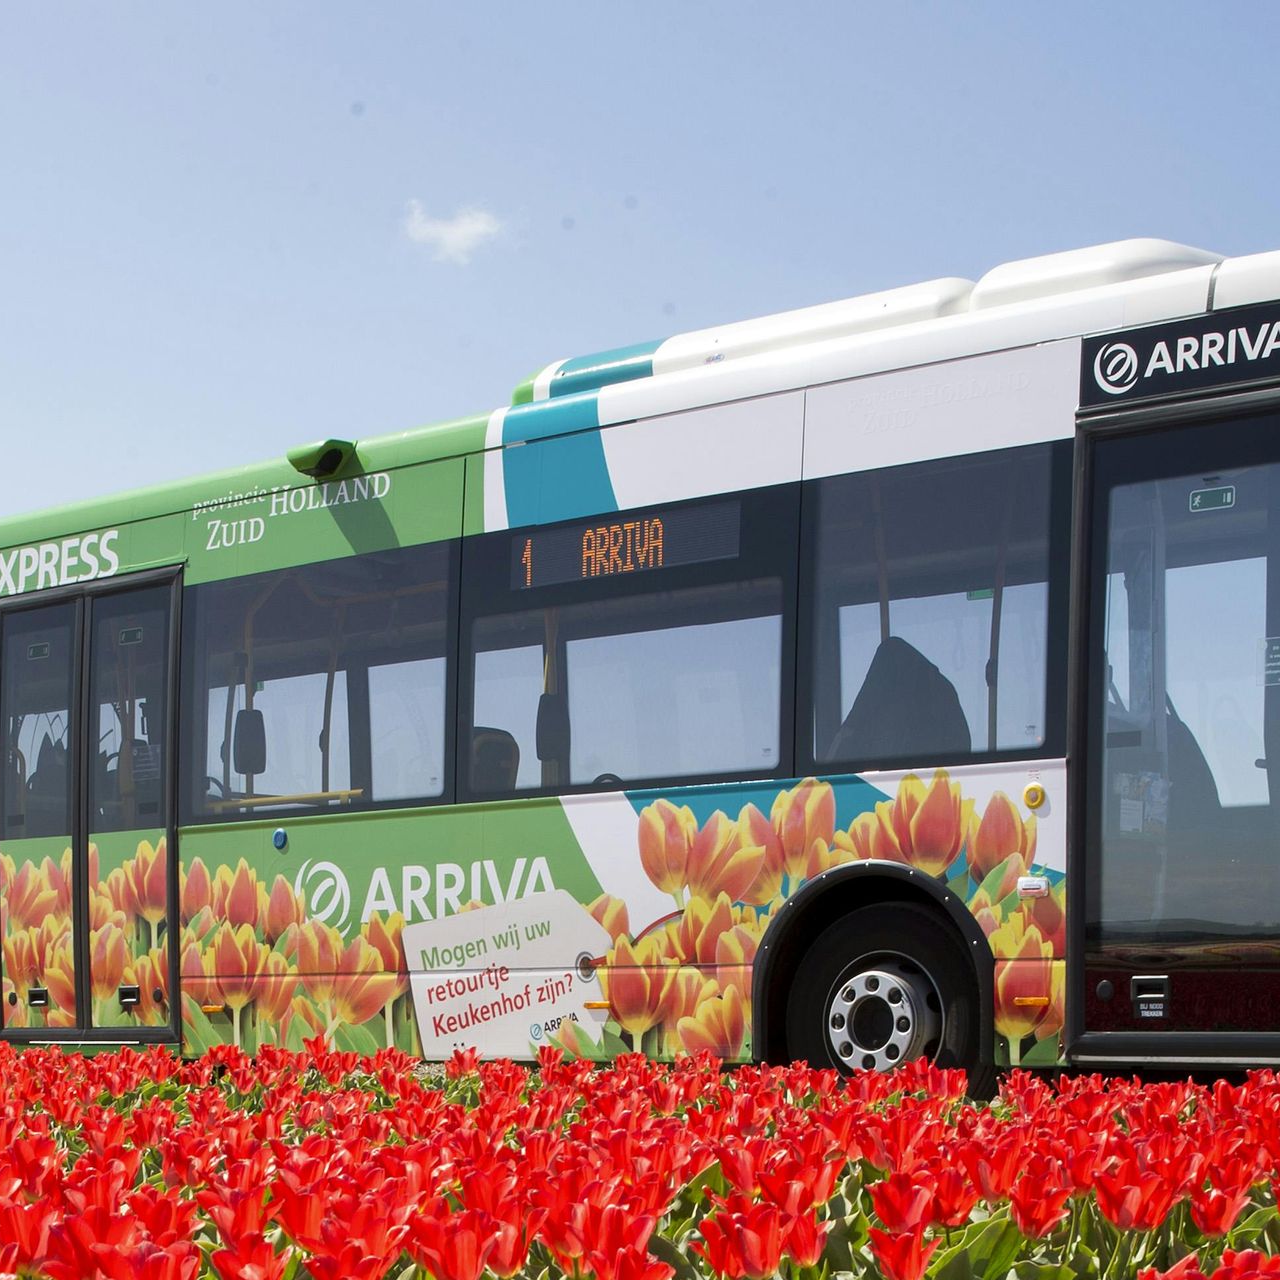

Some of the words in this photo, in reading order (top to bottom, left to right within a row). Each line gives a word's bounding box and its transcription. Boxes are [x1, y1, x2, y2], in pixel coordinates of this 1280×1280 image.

[269, 472, 391, 517] HOLLAND
[206, 517, 265, 550] ZUID
[521, 538, 532, 587] 1
[582, 518, 664, 578] ARRIVA
[360, 856, 556, 924] ARRIVA
[421, 938, 488, 971] Mogen
[492, 923, 521, 951] wij
[525, 920, 552, 942] uw
[427, 963, 510, 1005] retourtje
[432, 984, 531, 1037] Keukenhof
[536, 973, 574, 1005] zijn?
[543, 1012, 579, 1034] ARRA
